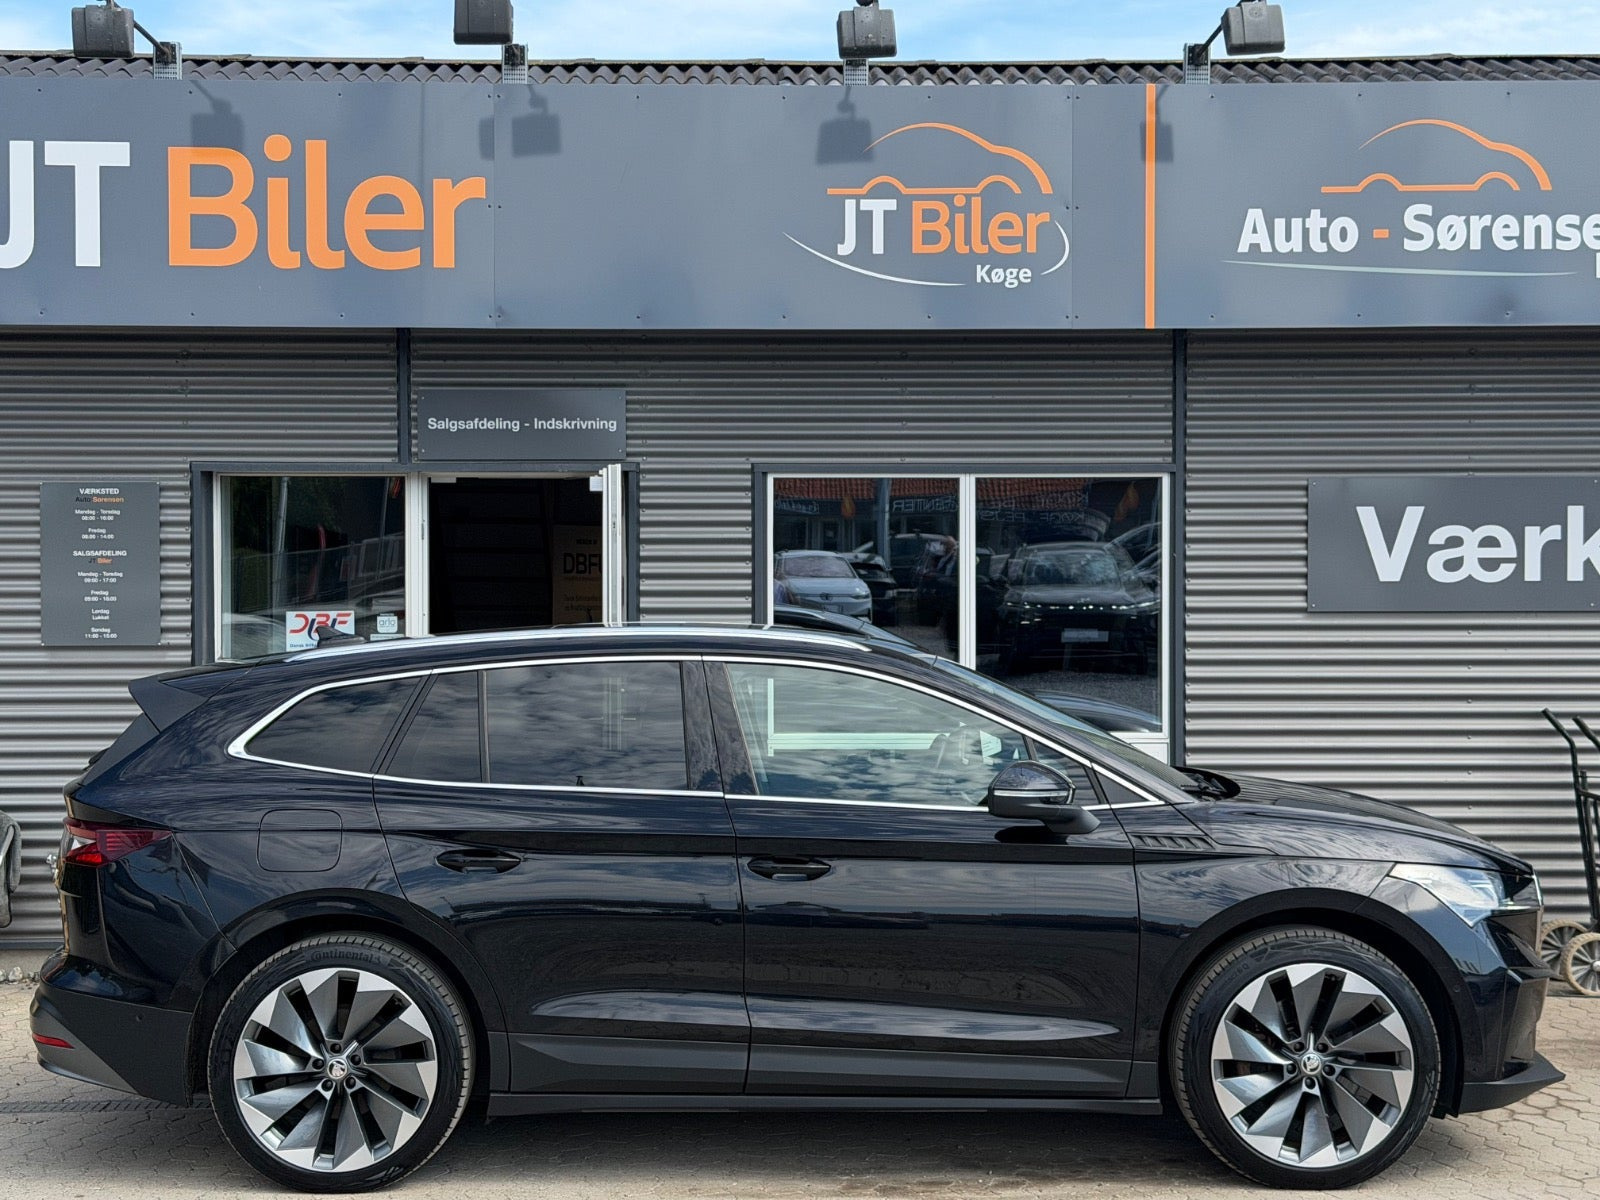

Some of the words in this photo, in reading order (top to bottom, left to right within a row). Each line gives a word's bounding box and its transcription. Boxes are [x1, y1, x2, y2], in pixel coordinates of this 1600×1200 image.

[0, 140, 131, 269] JT
[167, 134, 487, 270] Biler
[837, 199, 897, 256] JT
[912, 194, 1050, 254] Biler
[1237, 208, 1360, 253] Auto
[1373, 228, 1390, 239] -
[1403, 203, 1600, 251] Sørense
[975, 264, 1032, 289] Køge
[427, 417, 521, 432] Salgsafdeling
[534, 417, 618, 432] Indskrivning
[1356, 505, 1600, 583] Værk
[563, 552, 602, 574] DBF
[311, 950, 373, 963] Continental
